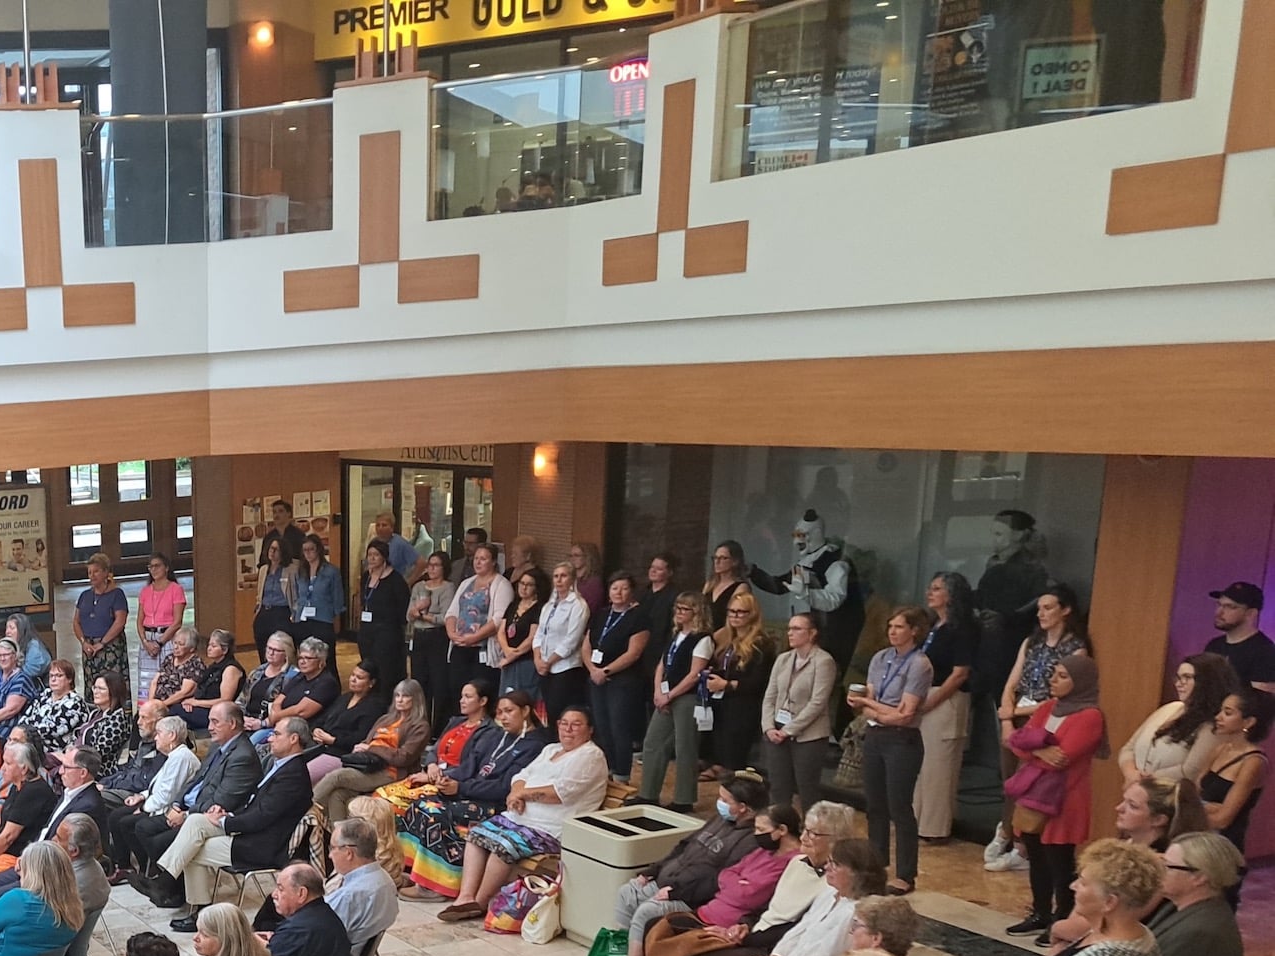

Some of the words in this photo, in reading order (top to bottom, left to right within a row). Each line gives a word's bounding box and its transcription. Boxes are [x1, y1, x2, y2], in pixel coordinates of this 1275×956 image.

[333, 0, 450, 35] PREMIER
[610, 61, 650, 83] OPEN
[460, 444, 495, 463] Cent
[13, 519, 39, 529] CAREER
